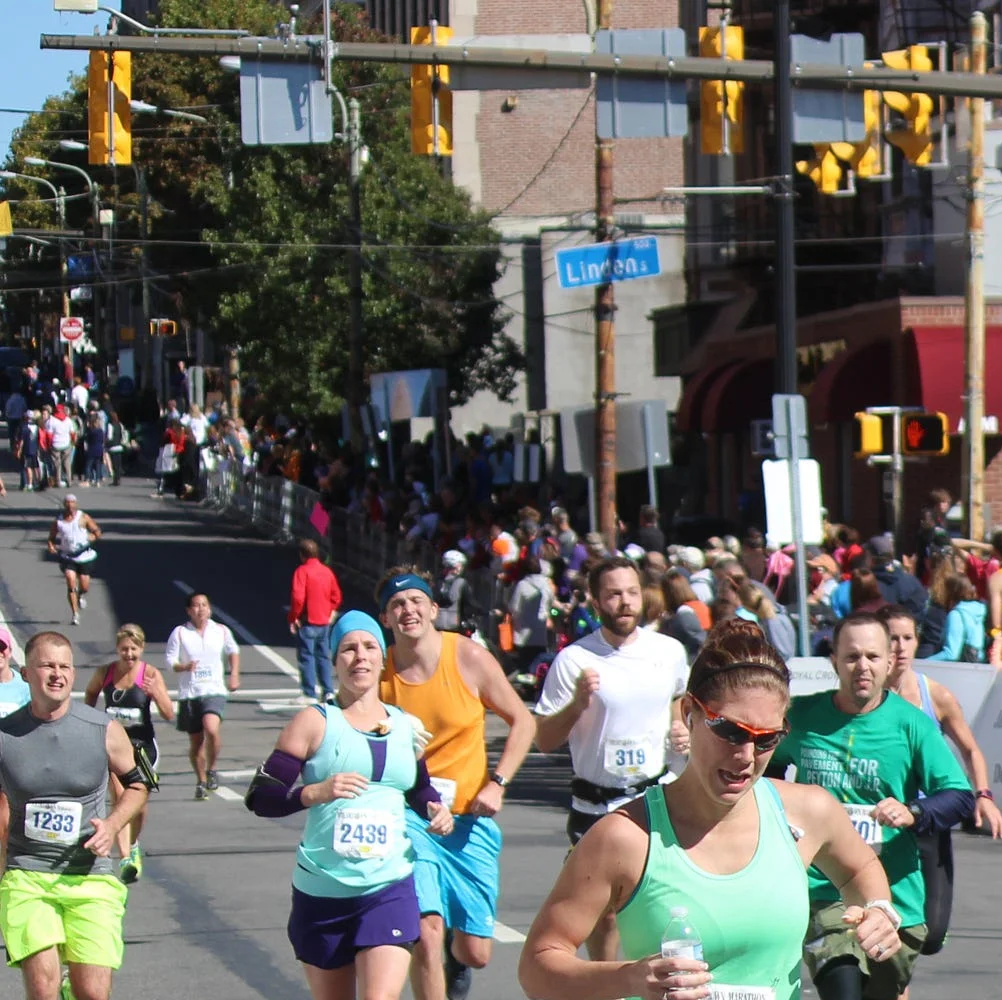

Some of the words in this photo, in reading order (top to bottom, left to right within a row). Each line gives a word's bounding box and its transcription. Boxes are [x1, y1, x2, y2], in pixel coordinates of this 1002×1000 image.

[565, 257, 638, 283] Linden
[615, 748, 646, 766] 319
[849, 758, 878, 777] FOR
[806, 770, 841, 788] PEYTON
[842, 773, 862, 789] AND
[33, 811, 74, 833] 1233
[340, 823, 387, 844] 2439
